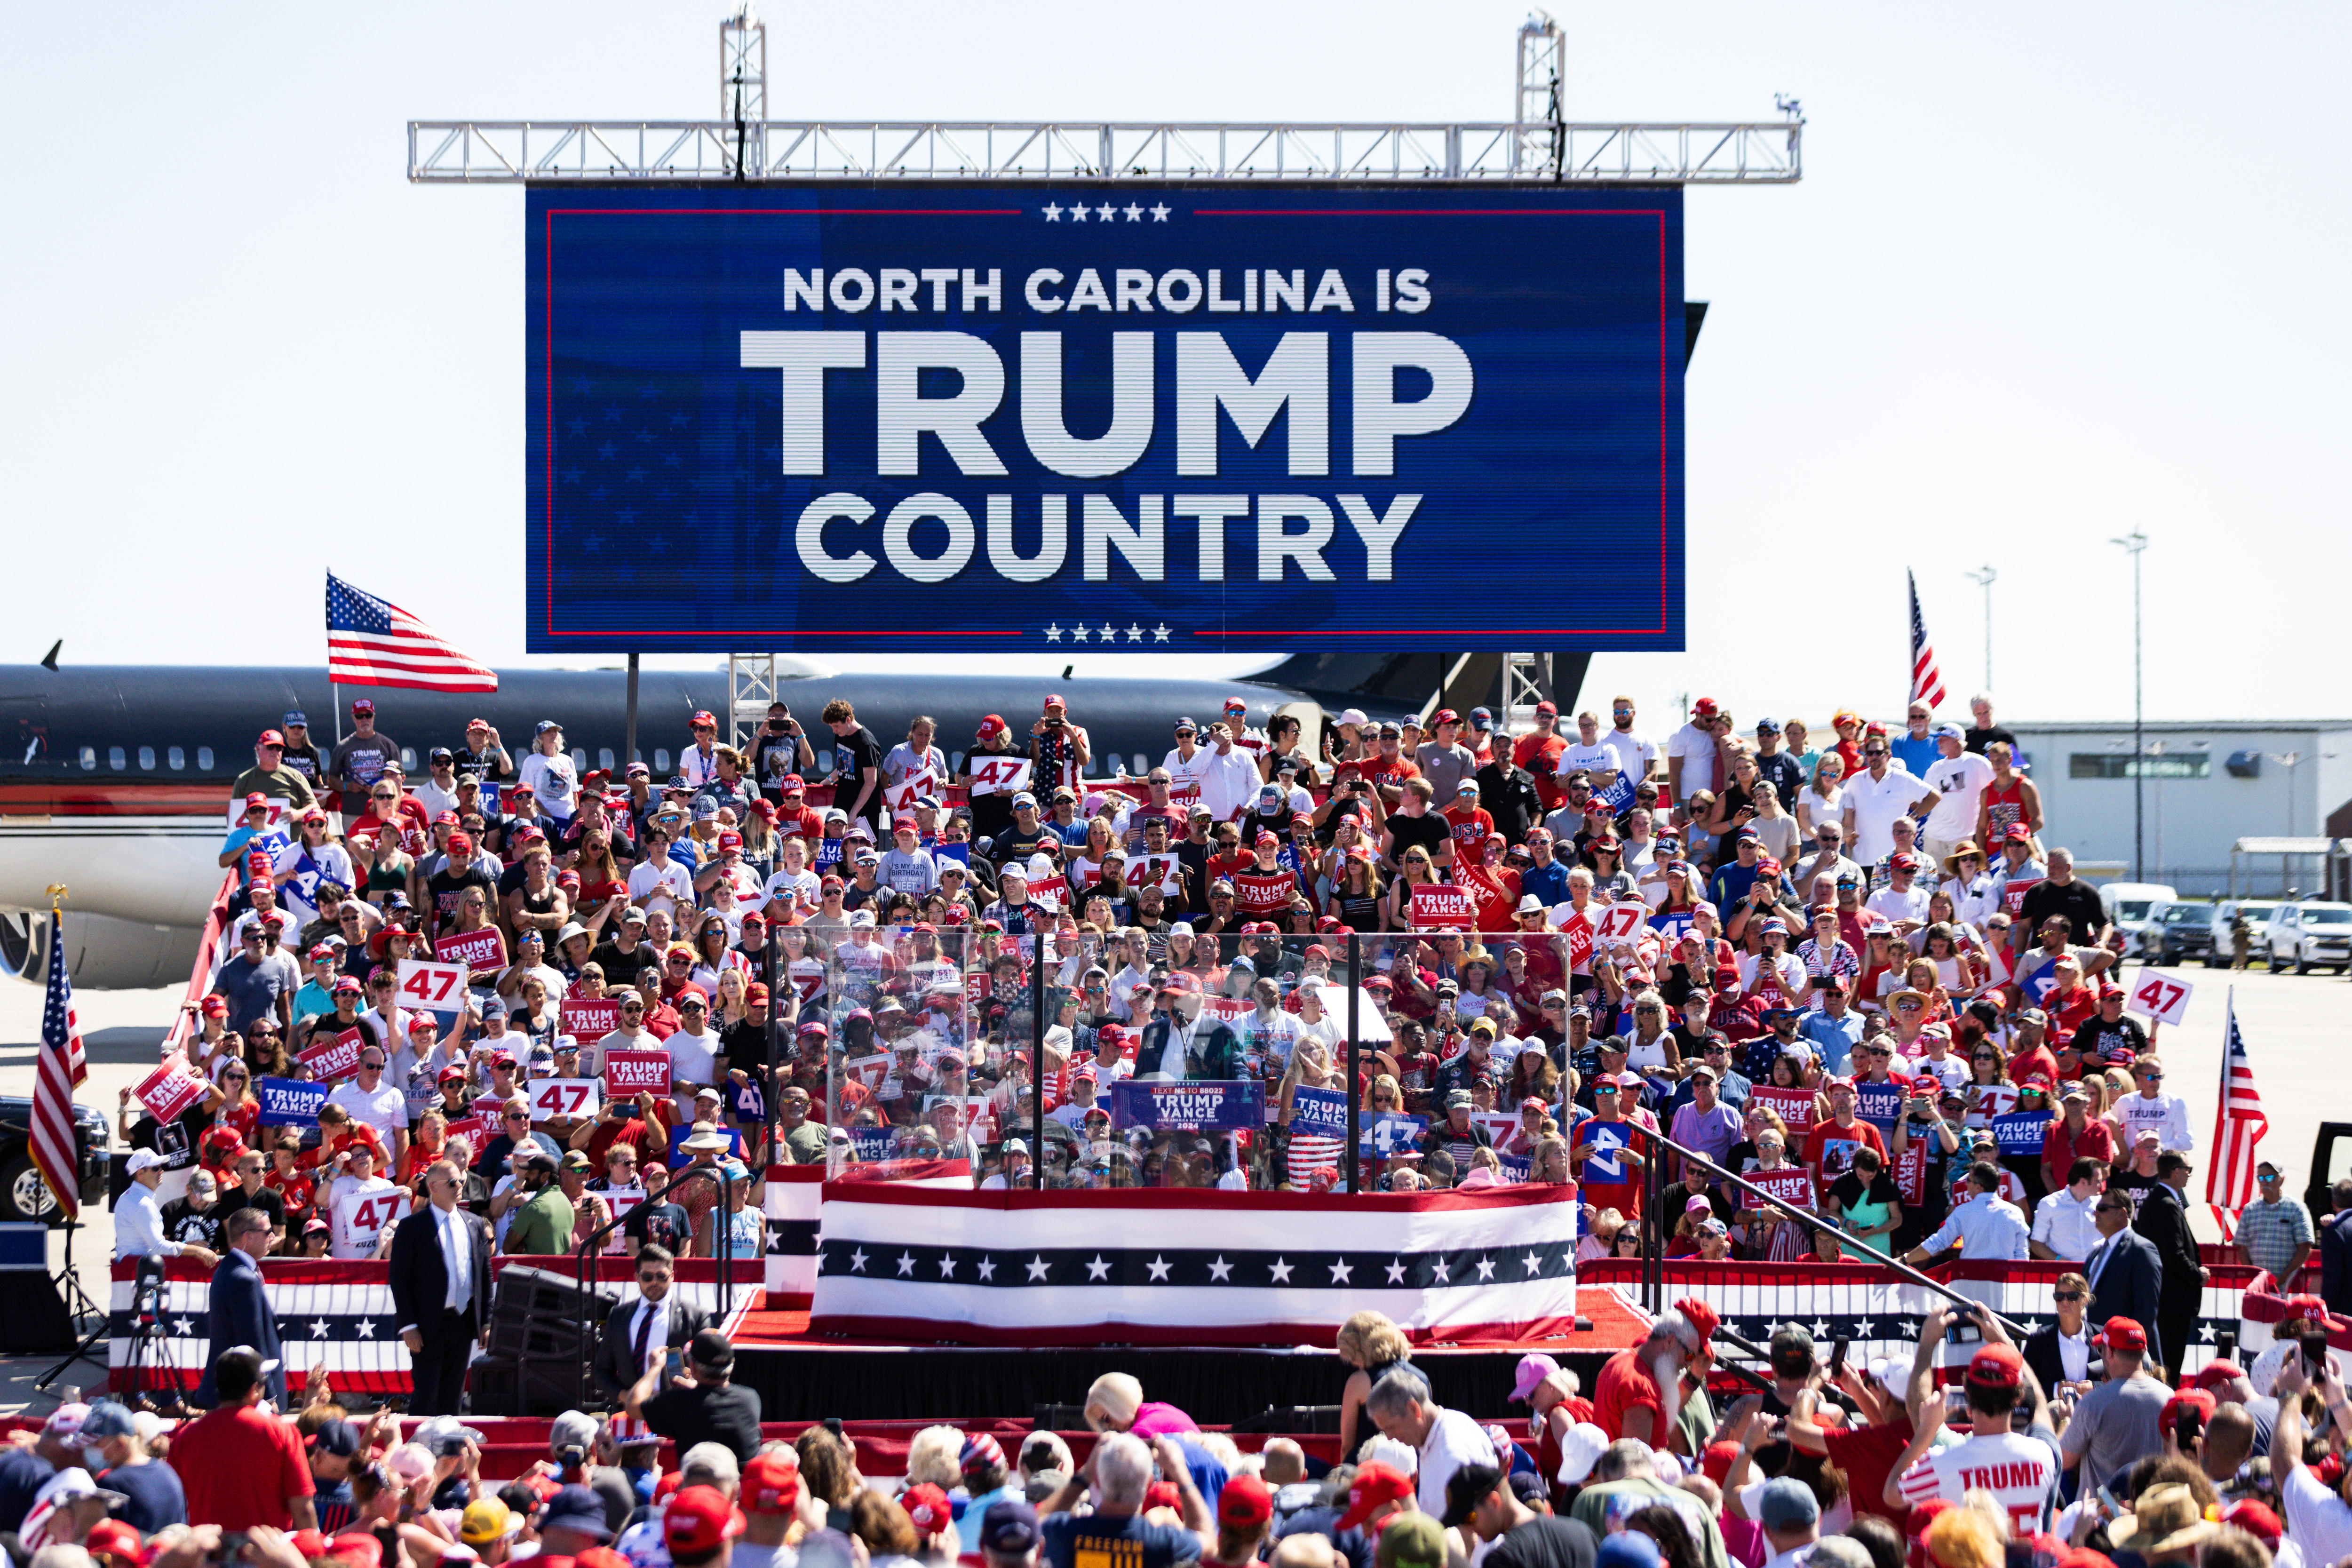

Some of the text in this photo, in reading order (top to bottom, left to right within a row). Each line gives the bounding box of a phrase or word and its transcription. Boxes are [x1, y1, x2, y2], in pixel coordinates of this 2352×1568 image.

[783, 267, 1431, 312] NORTH CAROLINA IS
[740, 330, 1474, 478] TRUMP
[795, 492, 1423, 582] COUNTRY
[977, 762, 1022, 785] 47
[1375, 772, 1404, 787] USA
[784, 780, 800, 790] MAGA
[897, 775, 933, 811] 47
[1600, 777, 1626, 798] UMP
[1609, 788, 1628, 804] NCE
[1453, 823, 1484, 840] USA
[895, 882, 916, 891] MEET
[1239, 880, 1293, 895] TRUMP
[1107, 897, 1126, 906] RUMP
[1246, 890, 1286, 902] VANCE
[1415, 895, 1473, 906] TRUMP
[1421, 905, 1466, 914] VANCE
[1597, 908, 1639, 938] 47
[440, 938, 497, 959] TRUMP
[404, 969, 458, 1001] 47
[2138, 979, 2185, 1013] 47
[565, 1009, 616, 1021] TRUM
[1716, 1008, 1752, 1028] USA
[571, 1020, 615, 1029] VANCE
[305, 1038, 360, 1070] TRUMP
[314, 1050, 360, 1076] VANCE
[609, 1061, 668, 1074] TRUMP
[143, 1062, 188, 1105] TRUMP
[617, 1073, 662, 1082] VANCE
[265, 1088, 325, 1104] TRUMP
[537, 1085, 589, 1114] 47
[1152, 1095, 1224, 1107] TRUMP
[1754, 1096, 1812, 1112] TRUMP
[272, 1099, 317, 1113] VANCE
[1160, 1107, 1215, 1118] VANCE
[1298, 1097, 1348, 1115] TRUM
[1854, 1103, 1893, 1115] ANCE
[1303, 1109, 1348, 1125] VANC
[1779, 1109, 1806, 1121] NCE
[2129, 1110, 2166, 1119] TRUMP
[1360, 1119, 1419, 1151] 47
[1997, 1131, 2042, 1141] VANCE
[861, 1150, 889, 1158] NCE
[1589, 1127, 1623, 1176] 47
[354, 1195, 402, 1231] 47
[1981, 1359, 2000, 1369] TRUMP
[1958, 1460, 2043, 1491] TRUMP
[314, 1493, 353, 1505] EEDOM
[1074, 1534, 1144, 1553] FREEDOM
